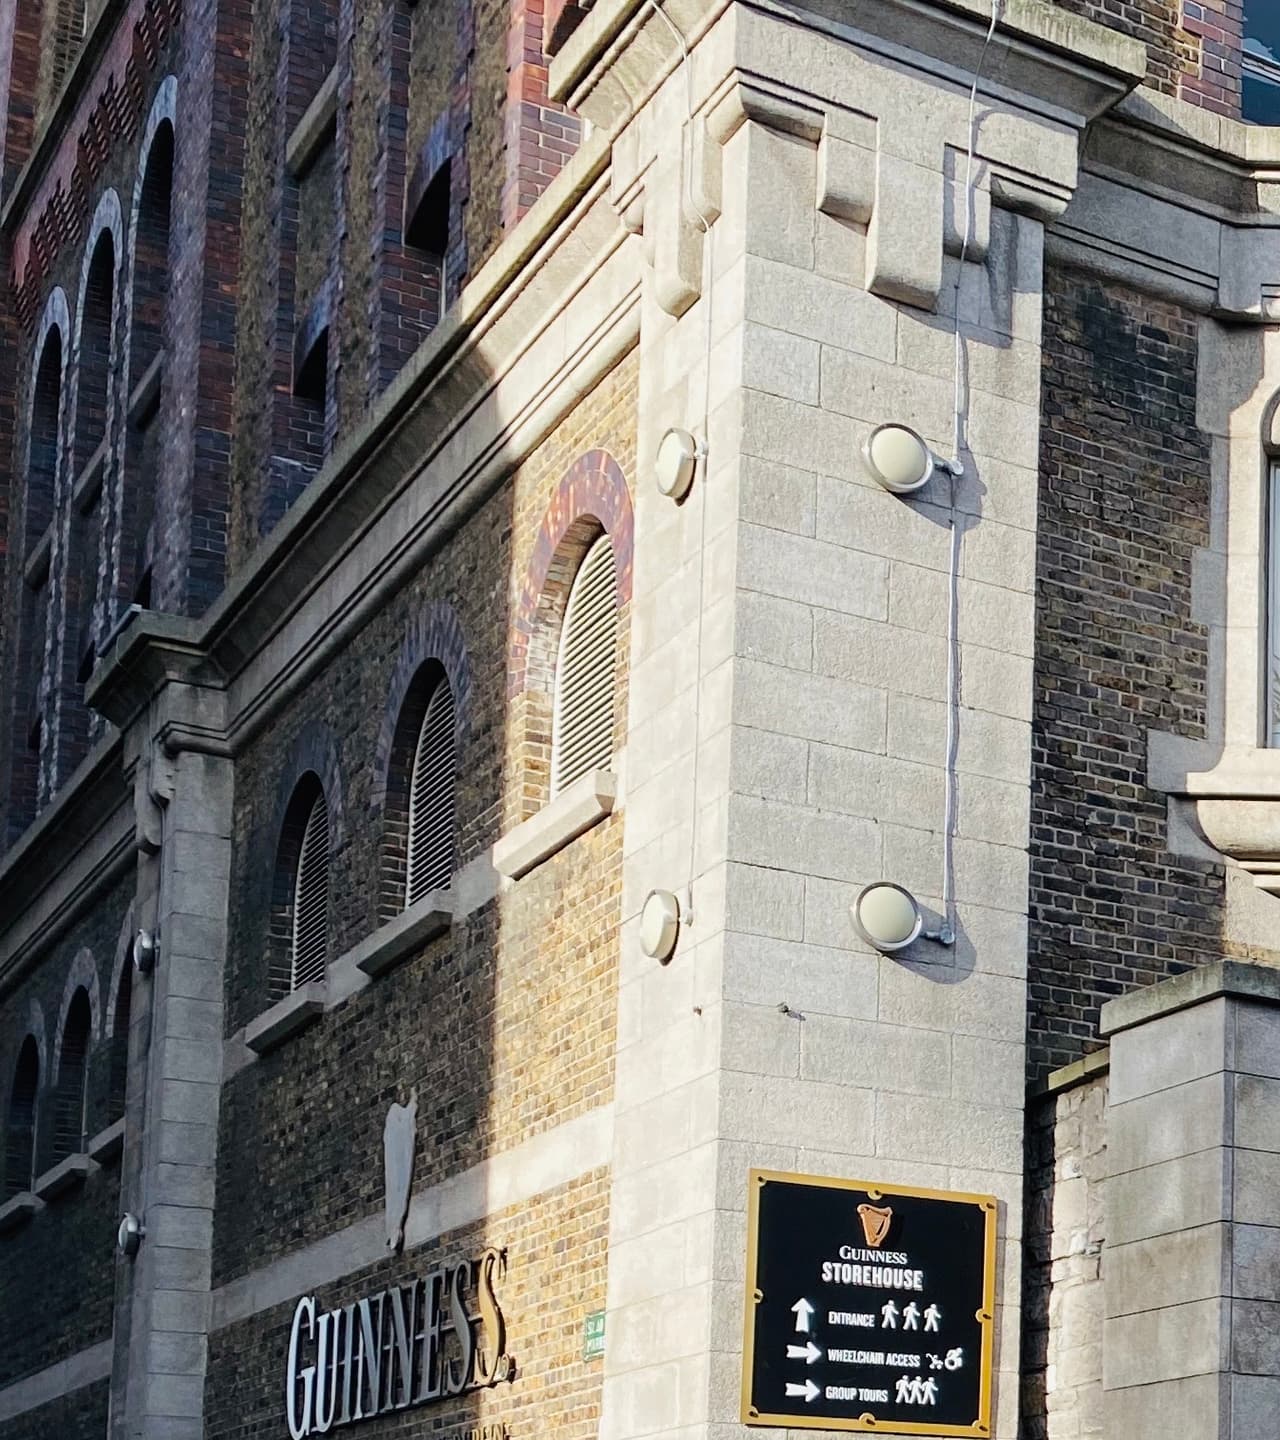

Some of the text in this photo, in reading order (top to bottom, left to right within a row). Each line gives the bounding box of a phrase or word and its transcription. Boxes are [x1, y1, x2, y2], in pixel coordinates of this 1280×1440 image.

[839, 1245, 907, 1265] GUINNESS
[821, 1261, 923, 1291] STOREHOUSE
[828, 1311, 875, 1327] ENTRANCE
[827, 1349, 920, 1367] WHEELCHAIR ACCESS
[825, 1386, 888, 1402] GROUP TOURS
